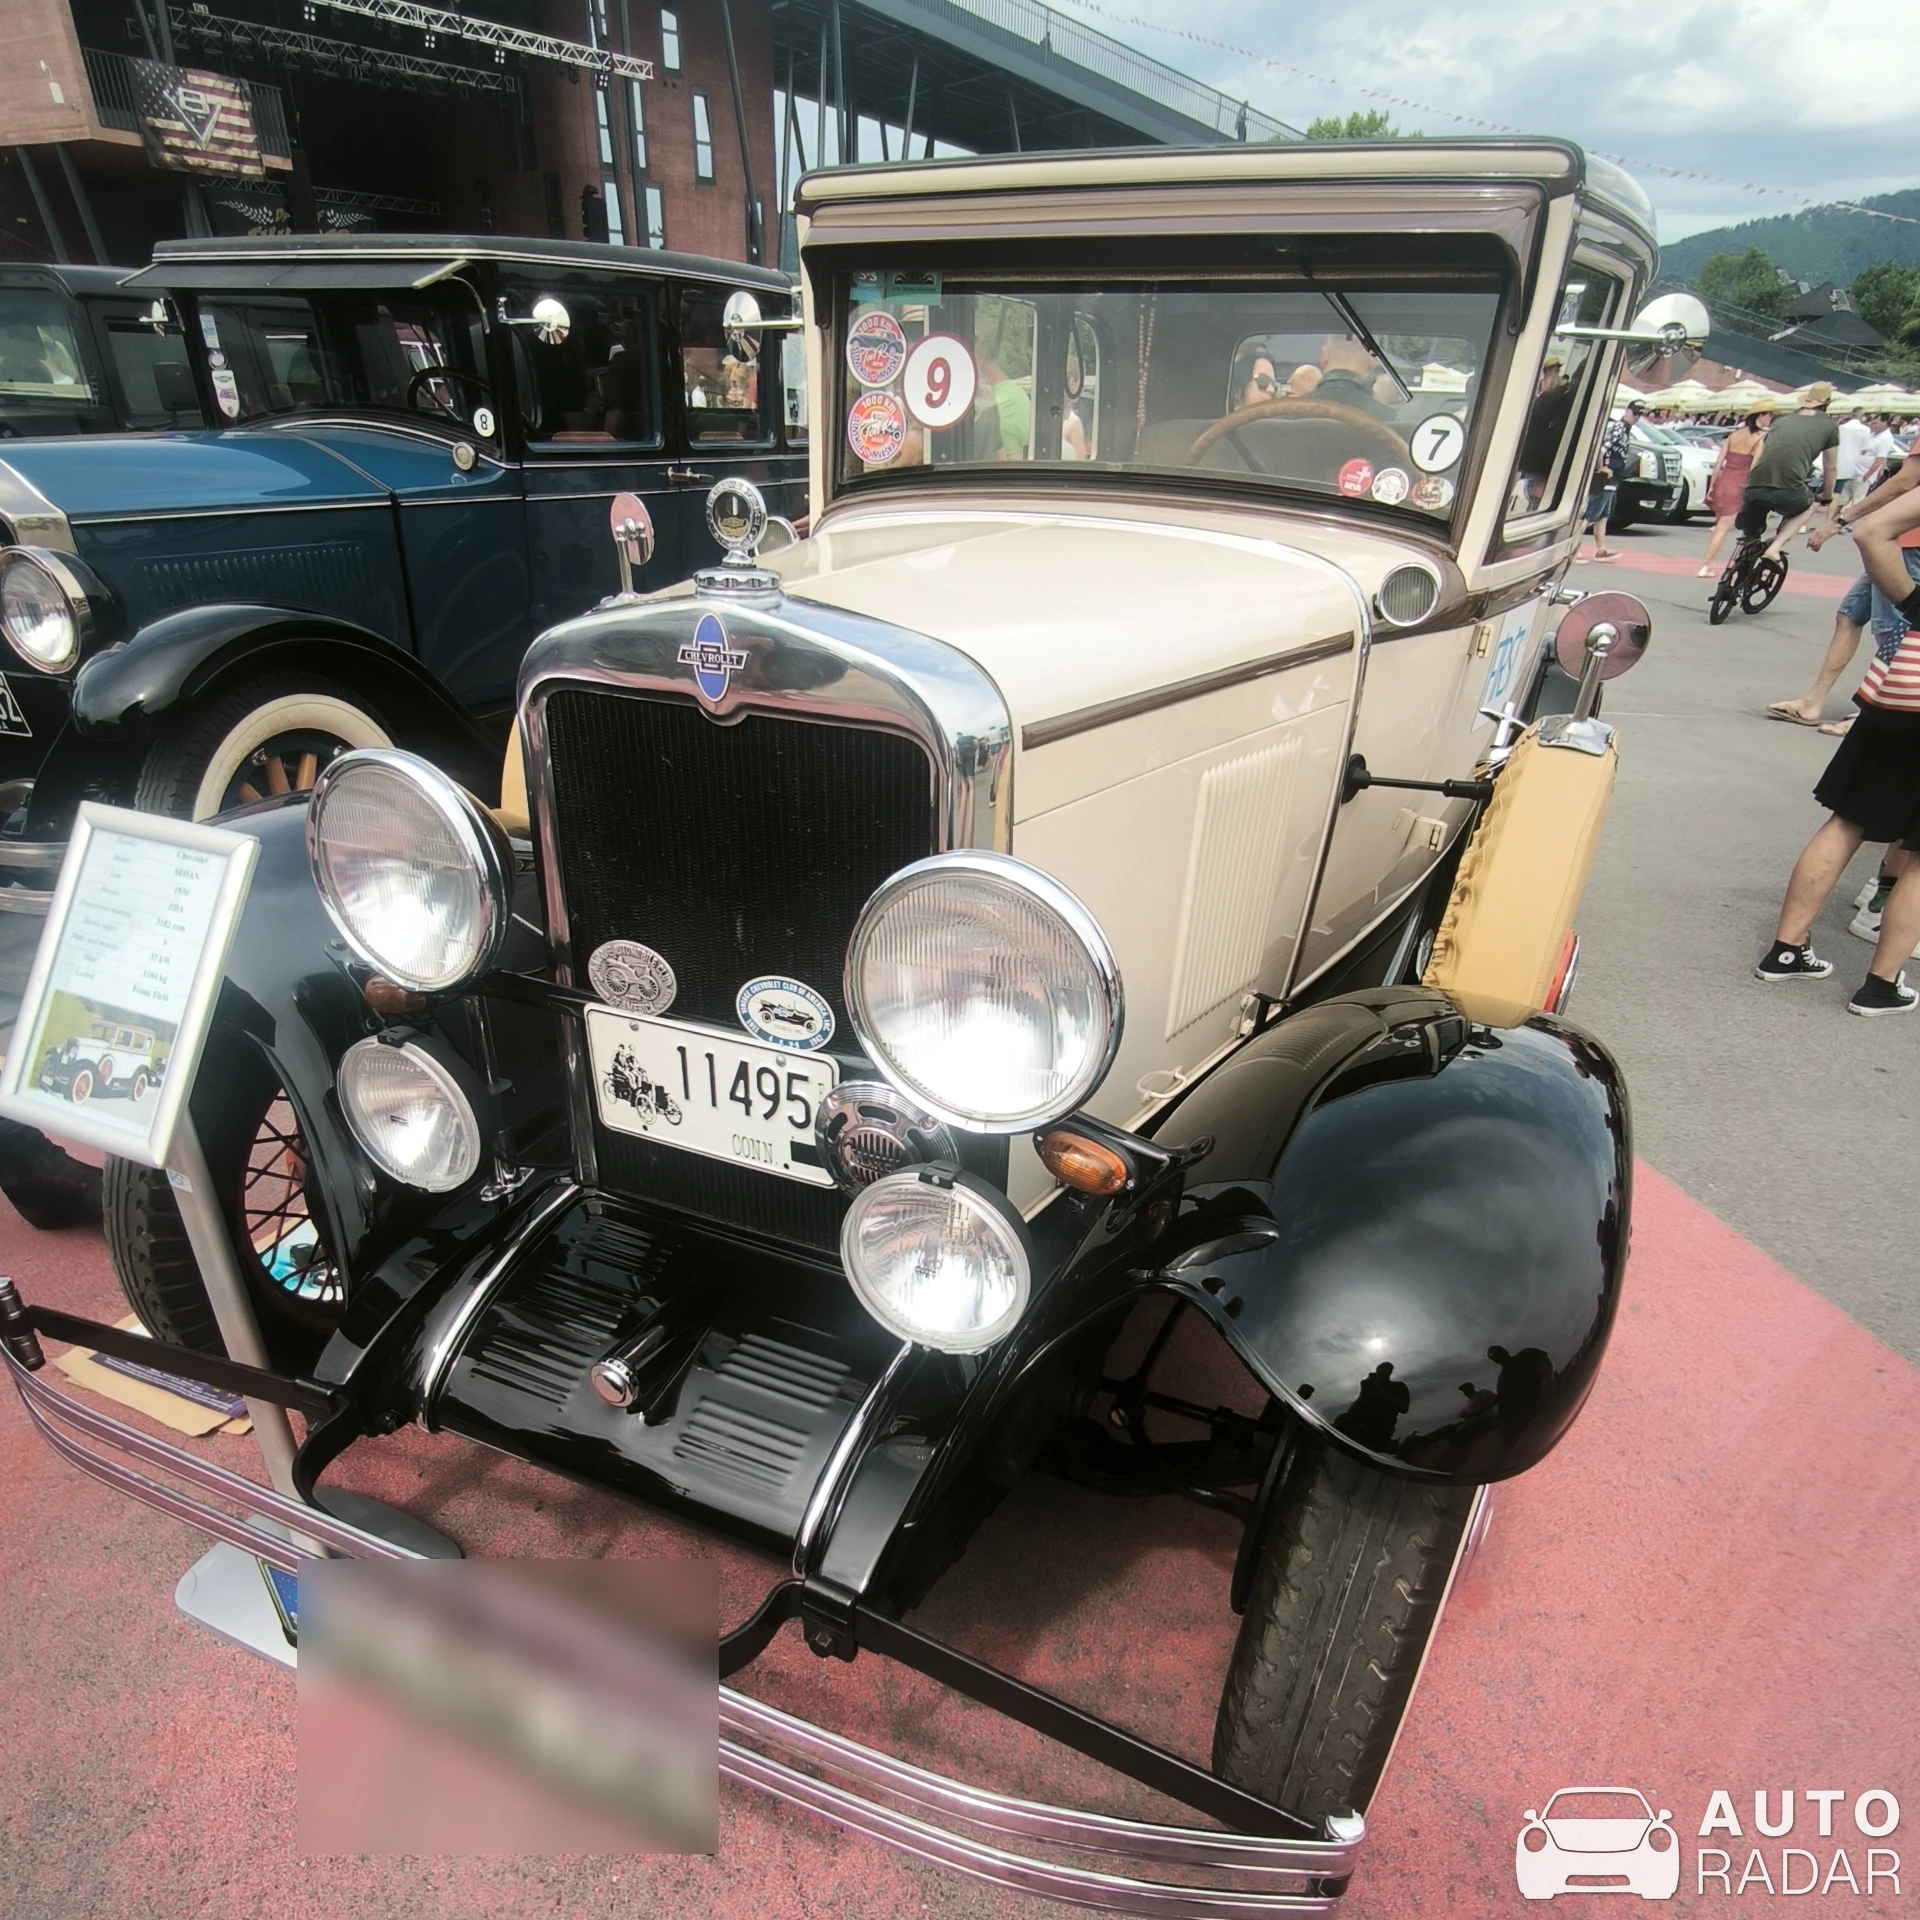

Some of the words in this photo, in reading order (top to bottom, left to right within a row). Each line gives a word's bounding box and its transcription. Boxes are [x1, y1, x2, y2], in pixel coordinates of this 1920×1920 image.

[858, 317, 879, 334] 1000
[925, 357, 951, 408] 9
[862, 395, 883, 409] 1000
[480, 413, 488, 430] 8
[1427, 428, 1451, 461] 7
[684, 650, 738, 666] CHEVROLET
[176, 851, 208, 865] Chevrolet
[174, 868, 200, 881] SEDAN
[749, 980, 781, 994] CHEVROLET
[782, 982, 799, 993] CLUB
[798, 987, 807, 997] OF
[676, 1045, 812, 1130] 11495
